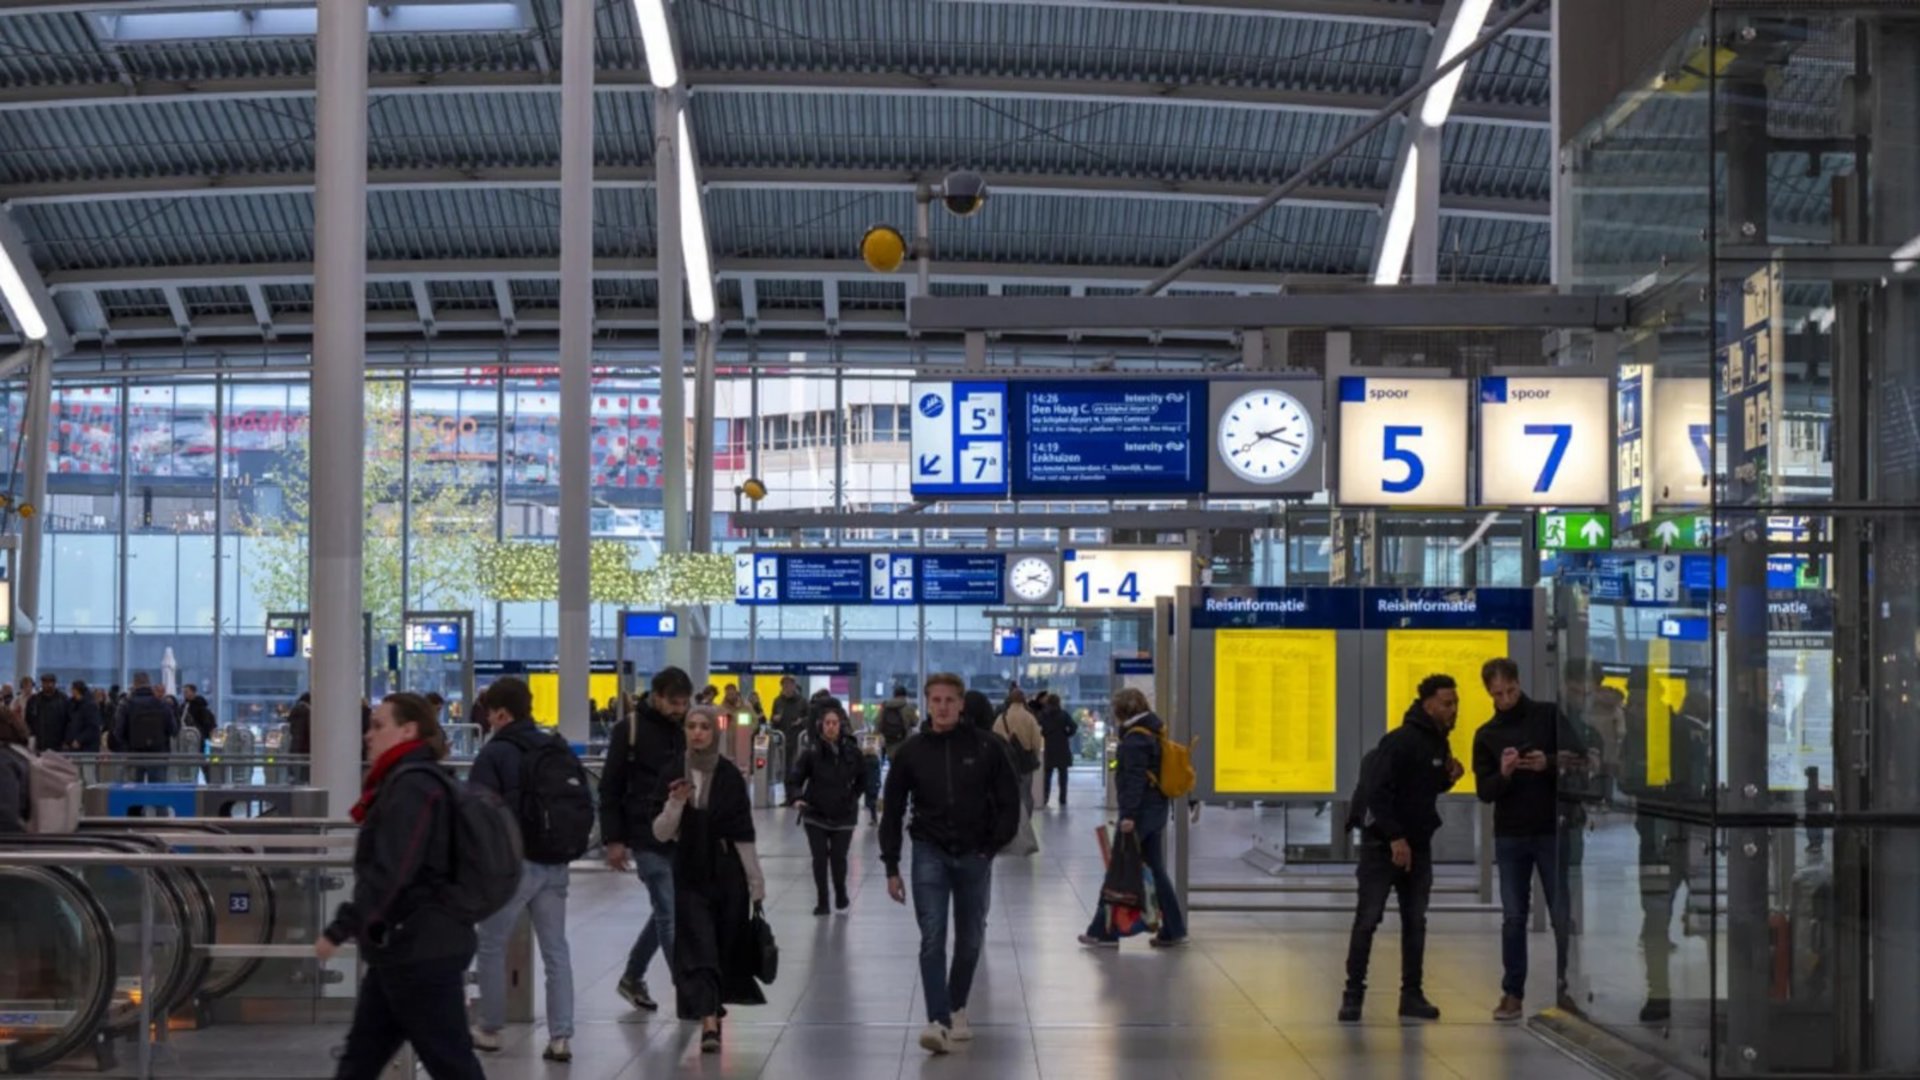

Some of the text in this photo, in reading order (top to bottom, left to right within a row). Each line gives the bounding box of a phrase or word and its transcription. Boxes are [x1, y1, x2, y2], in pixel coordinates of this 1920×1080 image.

[1124, 392, 1163, 405] Intercity
[1369, 387, 1410, 400] spoor
[1511, 387, 1552, 400] spoor
[1032, 404, 1052, 414] Den
[1053, 404, 1078, 417] Haag
[1032, 442, 1059, 452] 14:19
[1124, 442, 1163, 453] Intercity
[1032, 453, 1081, 463] Enkhuizen
[1381, 425, 1425, 493] 5
[1523, 424, 1573, 493] 7
[764, 565, 770, 575] 1
[899, 565, 906, 575] 3
[764, 586, 772, 597] 2
[1206, 598, 1305, 612] Reisinformatie
[1378, 598, 1477, 612] Reisinformatie
[1062, 638, 1079, 655] A
[231, 896, 248, 910] 33
